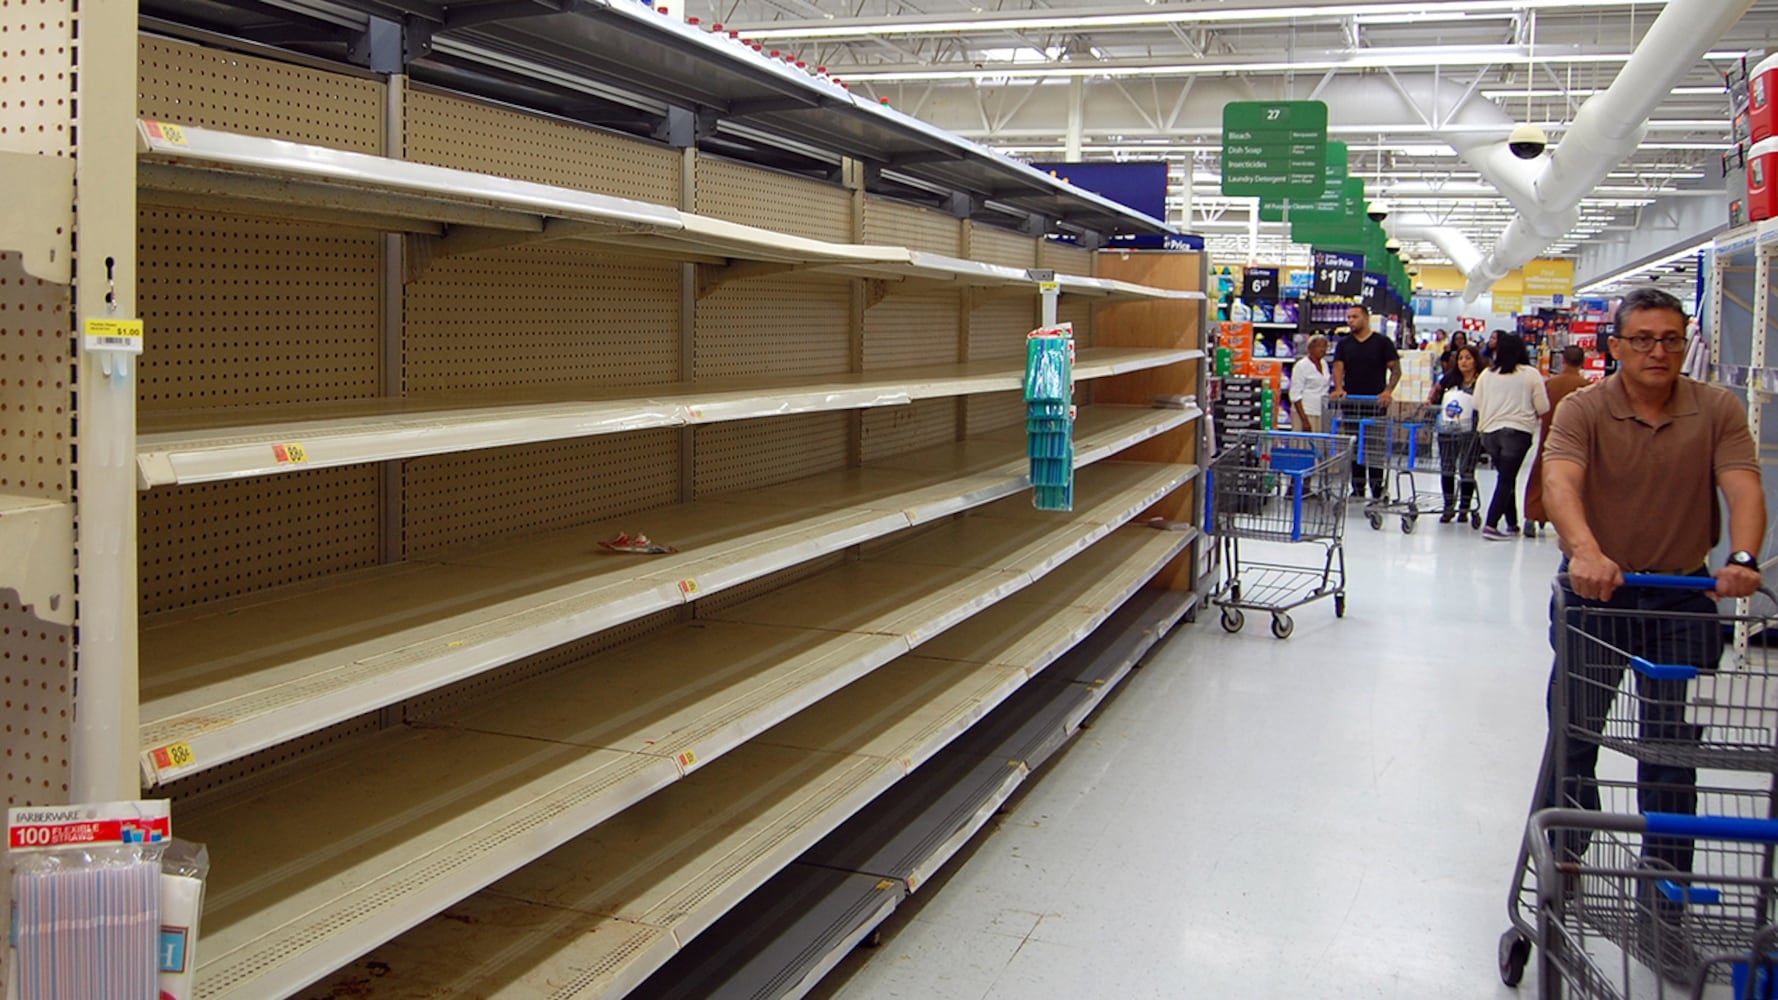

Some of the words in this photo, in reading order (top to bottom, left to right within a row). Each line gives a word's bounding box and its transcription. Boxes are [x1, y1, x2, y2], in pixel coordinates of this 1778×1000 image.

[1267, 109, 1280, 120] 27
[1228, 132, 1251, 140] Bleach
[1228, 146, 1243, 154] Dish
[1245, 146, 1262, 155] Soap
[1228, 175, 1254, 184] Laundry
[1255, 175, 1287, 184] Detergent
[1171, 240, 1190, 250] Price
[1325, 256, 1338, 266] Low
[1338, 258, 1354, 268] Price
[117, 328, 140, 336] $1.00
[171, 745, 190, 764] 88¢
[16, 809, 80, 823] FARBERWARE
[17, 827, 50, 845] 100
[52, 823, 99, 836] FLEXIBLE
[52, 833, 94, 844] STRAWS
